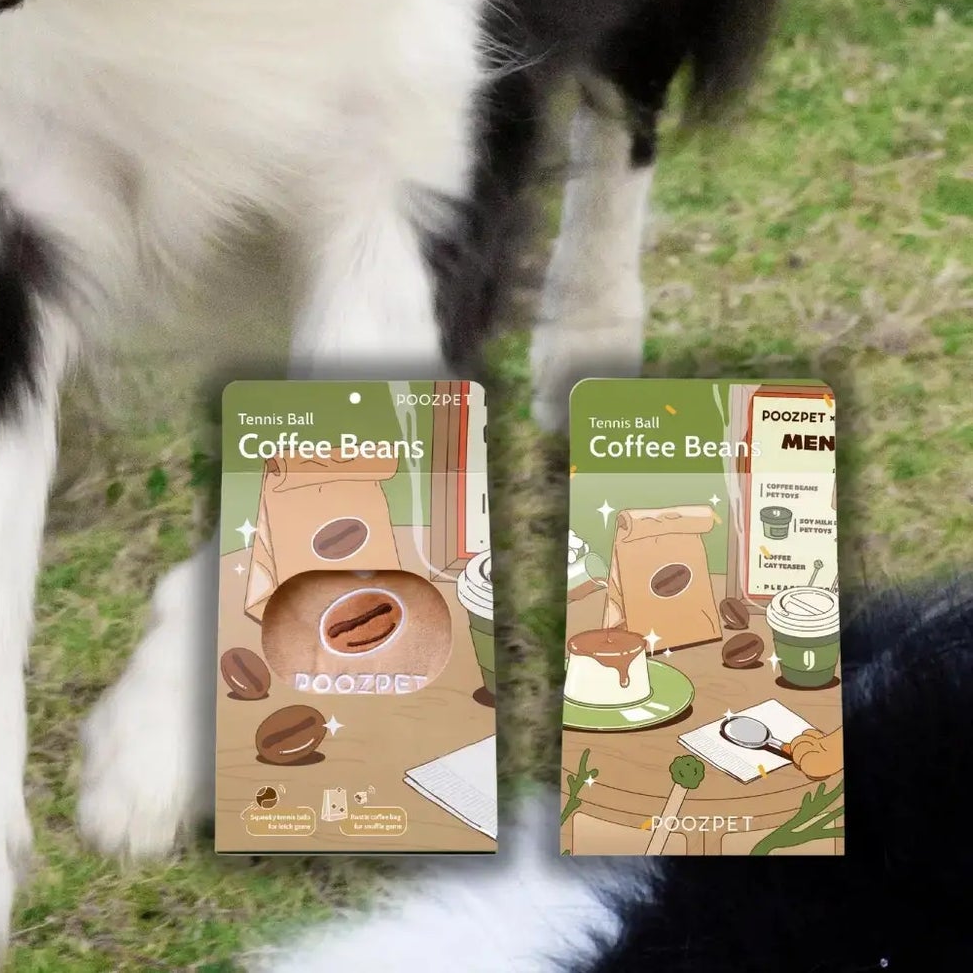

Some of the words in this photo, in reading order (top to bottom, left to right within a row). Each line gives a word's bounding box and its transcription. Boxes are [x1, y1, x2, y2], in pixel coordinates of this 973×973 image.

[397, 394, 473, 406] POOZPET
[238, 413, 283, 425] Tennis
[287, 413, 314, 425] Ball
[588, 417, 631, 428] Tennis
[635, 417, 660, 428] Ball
[762, 410, 826, 423] POOZPET
[238, 432, 331, 459] Coffee
[340, 433, 424, 459] Beans
[589, 434, 675, 458] Coffee
[685, 435, 762, 458] Beans
[295, 673, 427, 694] POOZPET
[651, 816, 753, 832] POOZPET
